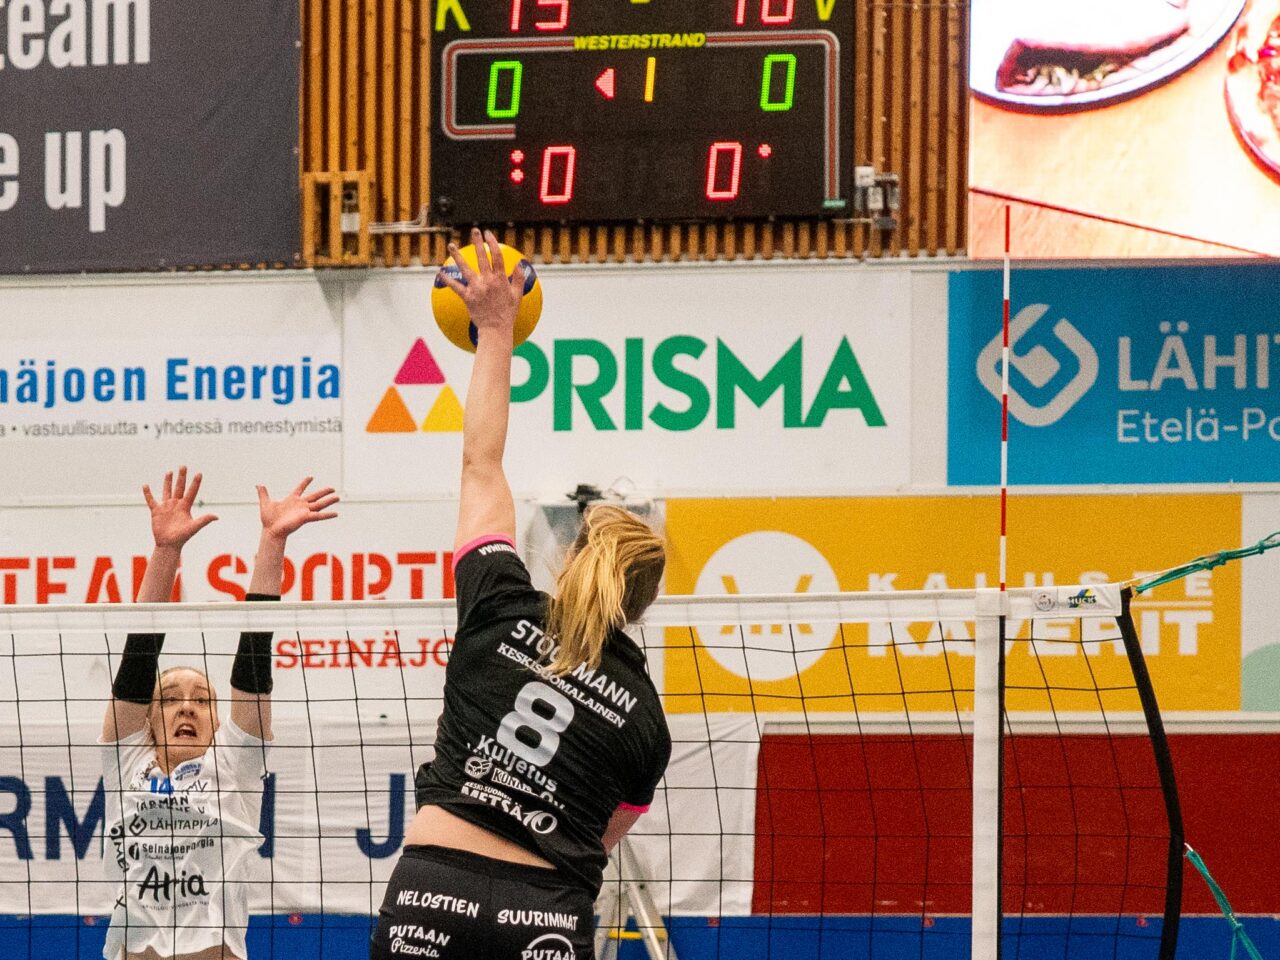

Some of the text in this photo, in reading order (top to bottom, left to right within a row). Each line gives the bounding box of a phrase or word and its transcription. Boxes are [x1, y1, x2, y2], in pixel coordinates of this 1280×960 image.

[574, 32, 706, 50] WESTERSTRAND
[486, 60, 523, 118] 0
[759, 53, 797, 112] 0
[44, 125, 127, 233] up
[1118, 320, 1280, 391] LÄHI
[166, 356, 341, 406] Energia
[23, 419, 138, 437] vastuullisuutta
[154, 418, 222, 439] yhdessä
[228, 416, 343, 438] menestymistä
[496, 681, 575, 767] 8
[150, 777, 175, 795] 14
[473, 735, 557, 792] Kuljetus
[396, 889, 578, 931] NELOSTIEN SUURIMMAT
[389, 924, 451, 947] PUTAAN
[391, 937, 440, 959] Pizzeria
